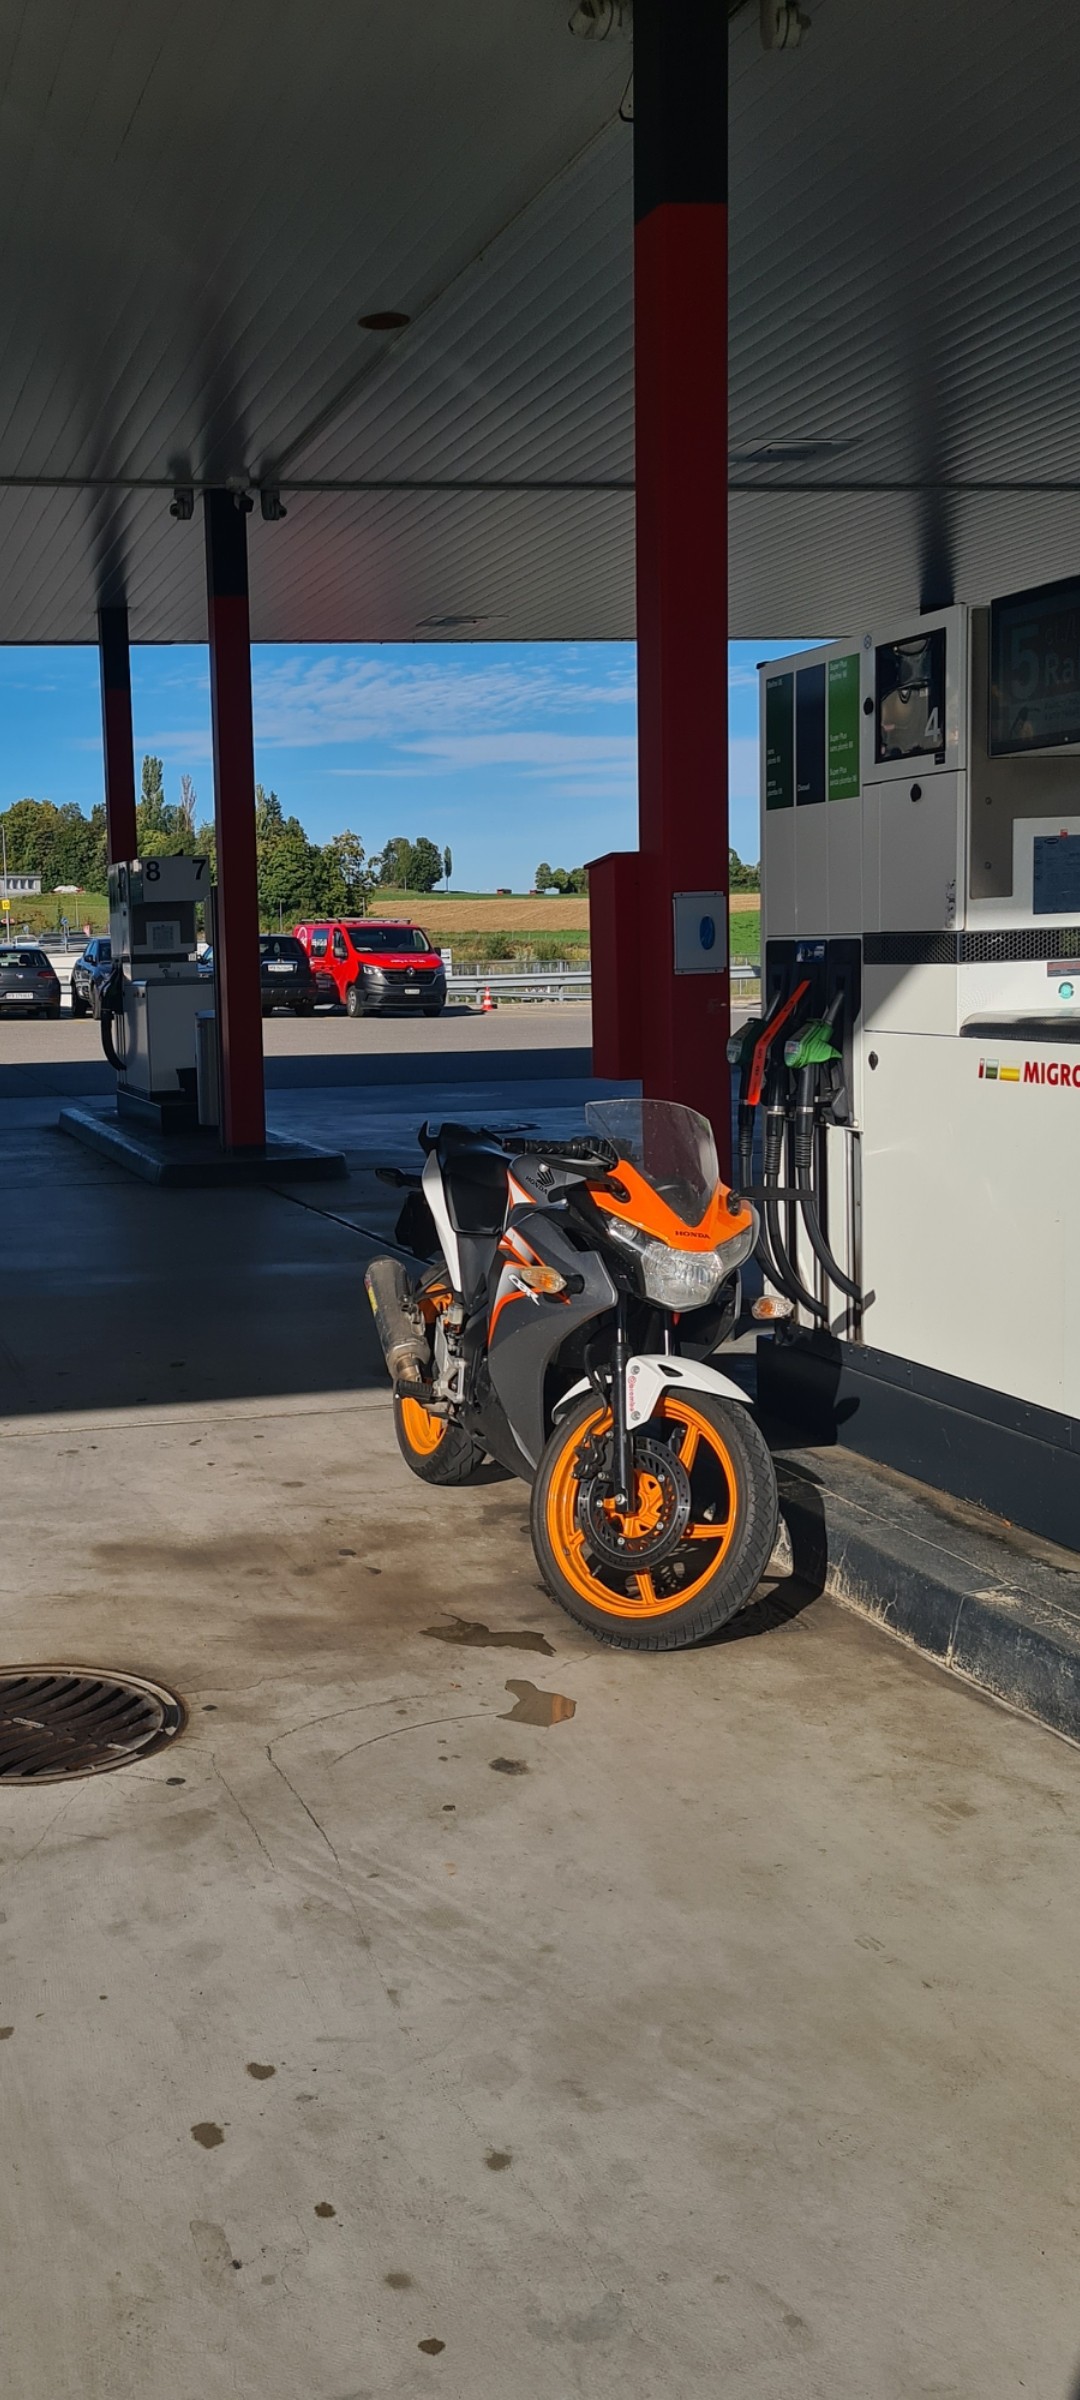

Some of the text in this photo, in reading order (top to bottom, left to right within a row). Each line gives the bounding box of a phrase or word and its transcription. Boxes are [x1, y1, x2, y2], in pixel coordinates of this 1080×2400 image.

[924, 706, 941, 743] 4
[146, 859, 207, 882] 8 7
[525, 1175, 548, 1195] HONDA
[675, 1230, 711, 1240] HONDA
[508, 1274, 540, 1306] CBR
